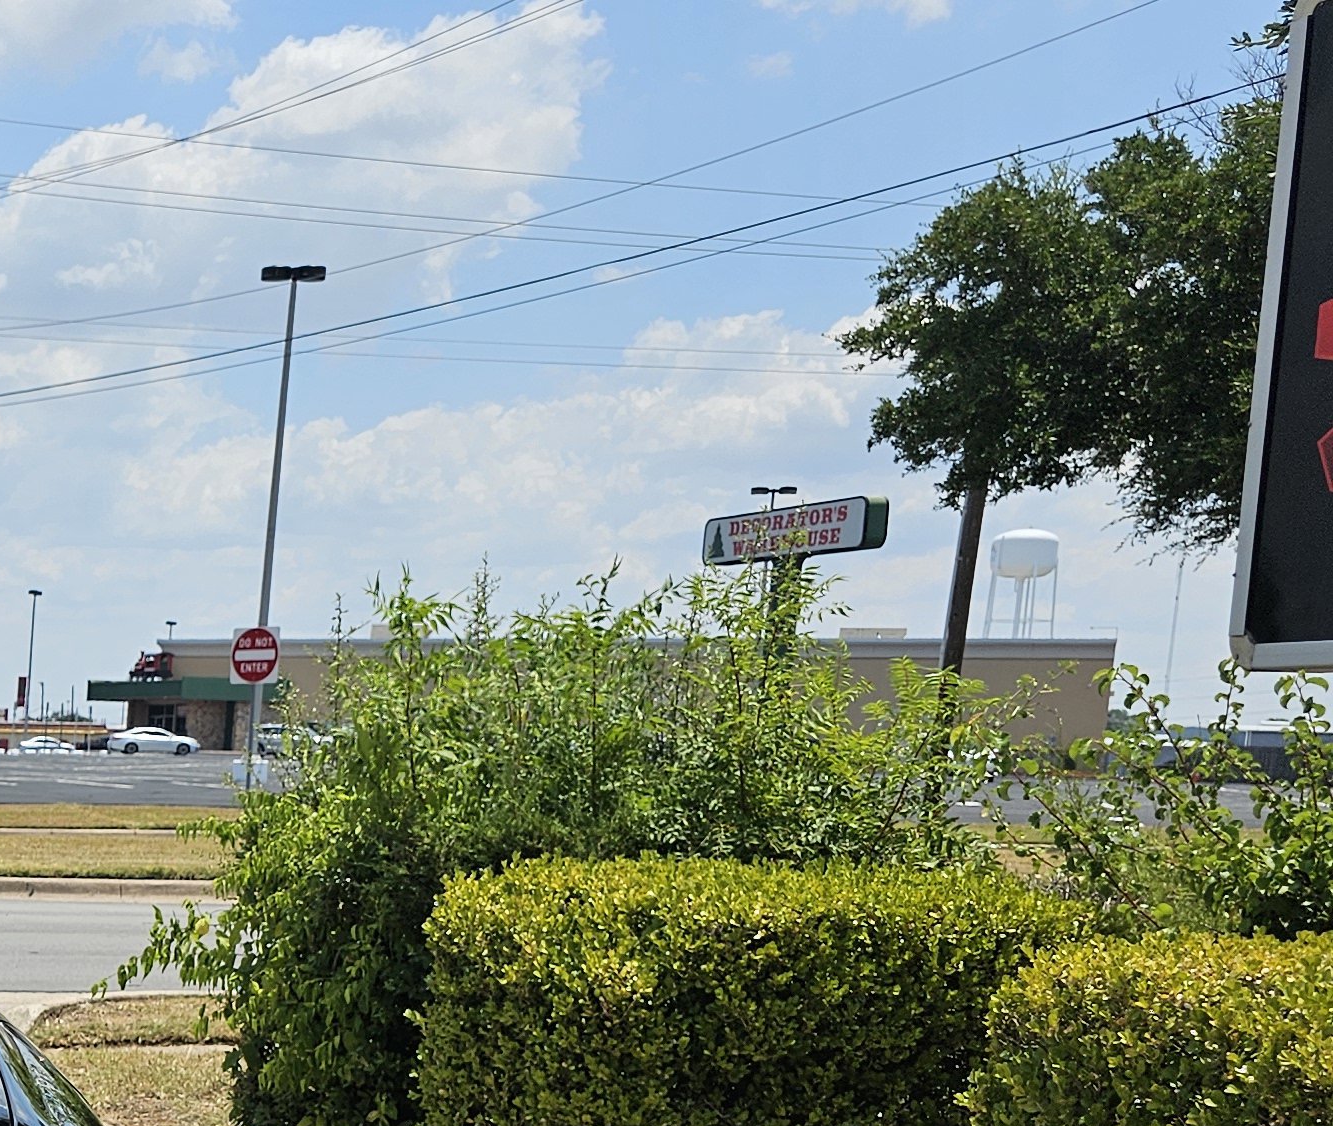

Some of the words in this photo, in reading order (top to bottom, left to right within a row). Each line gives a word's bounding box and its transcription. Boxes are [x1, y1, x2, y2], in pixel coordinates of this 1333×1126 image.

[729, 505, 848, 537] DECORATOR'S
[238, 637, 252, 649] DO
[255, 636, 273, 648] NOT
[240, 662, 268, 674] ENTER
